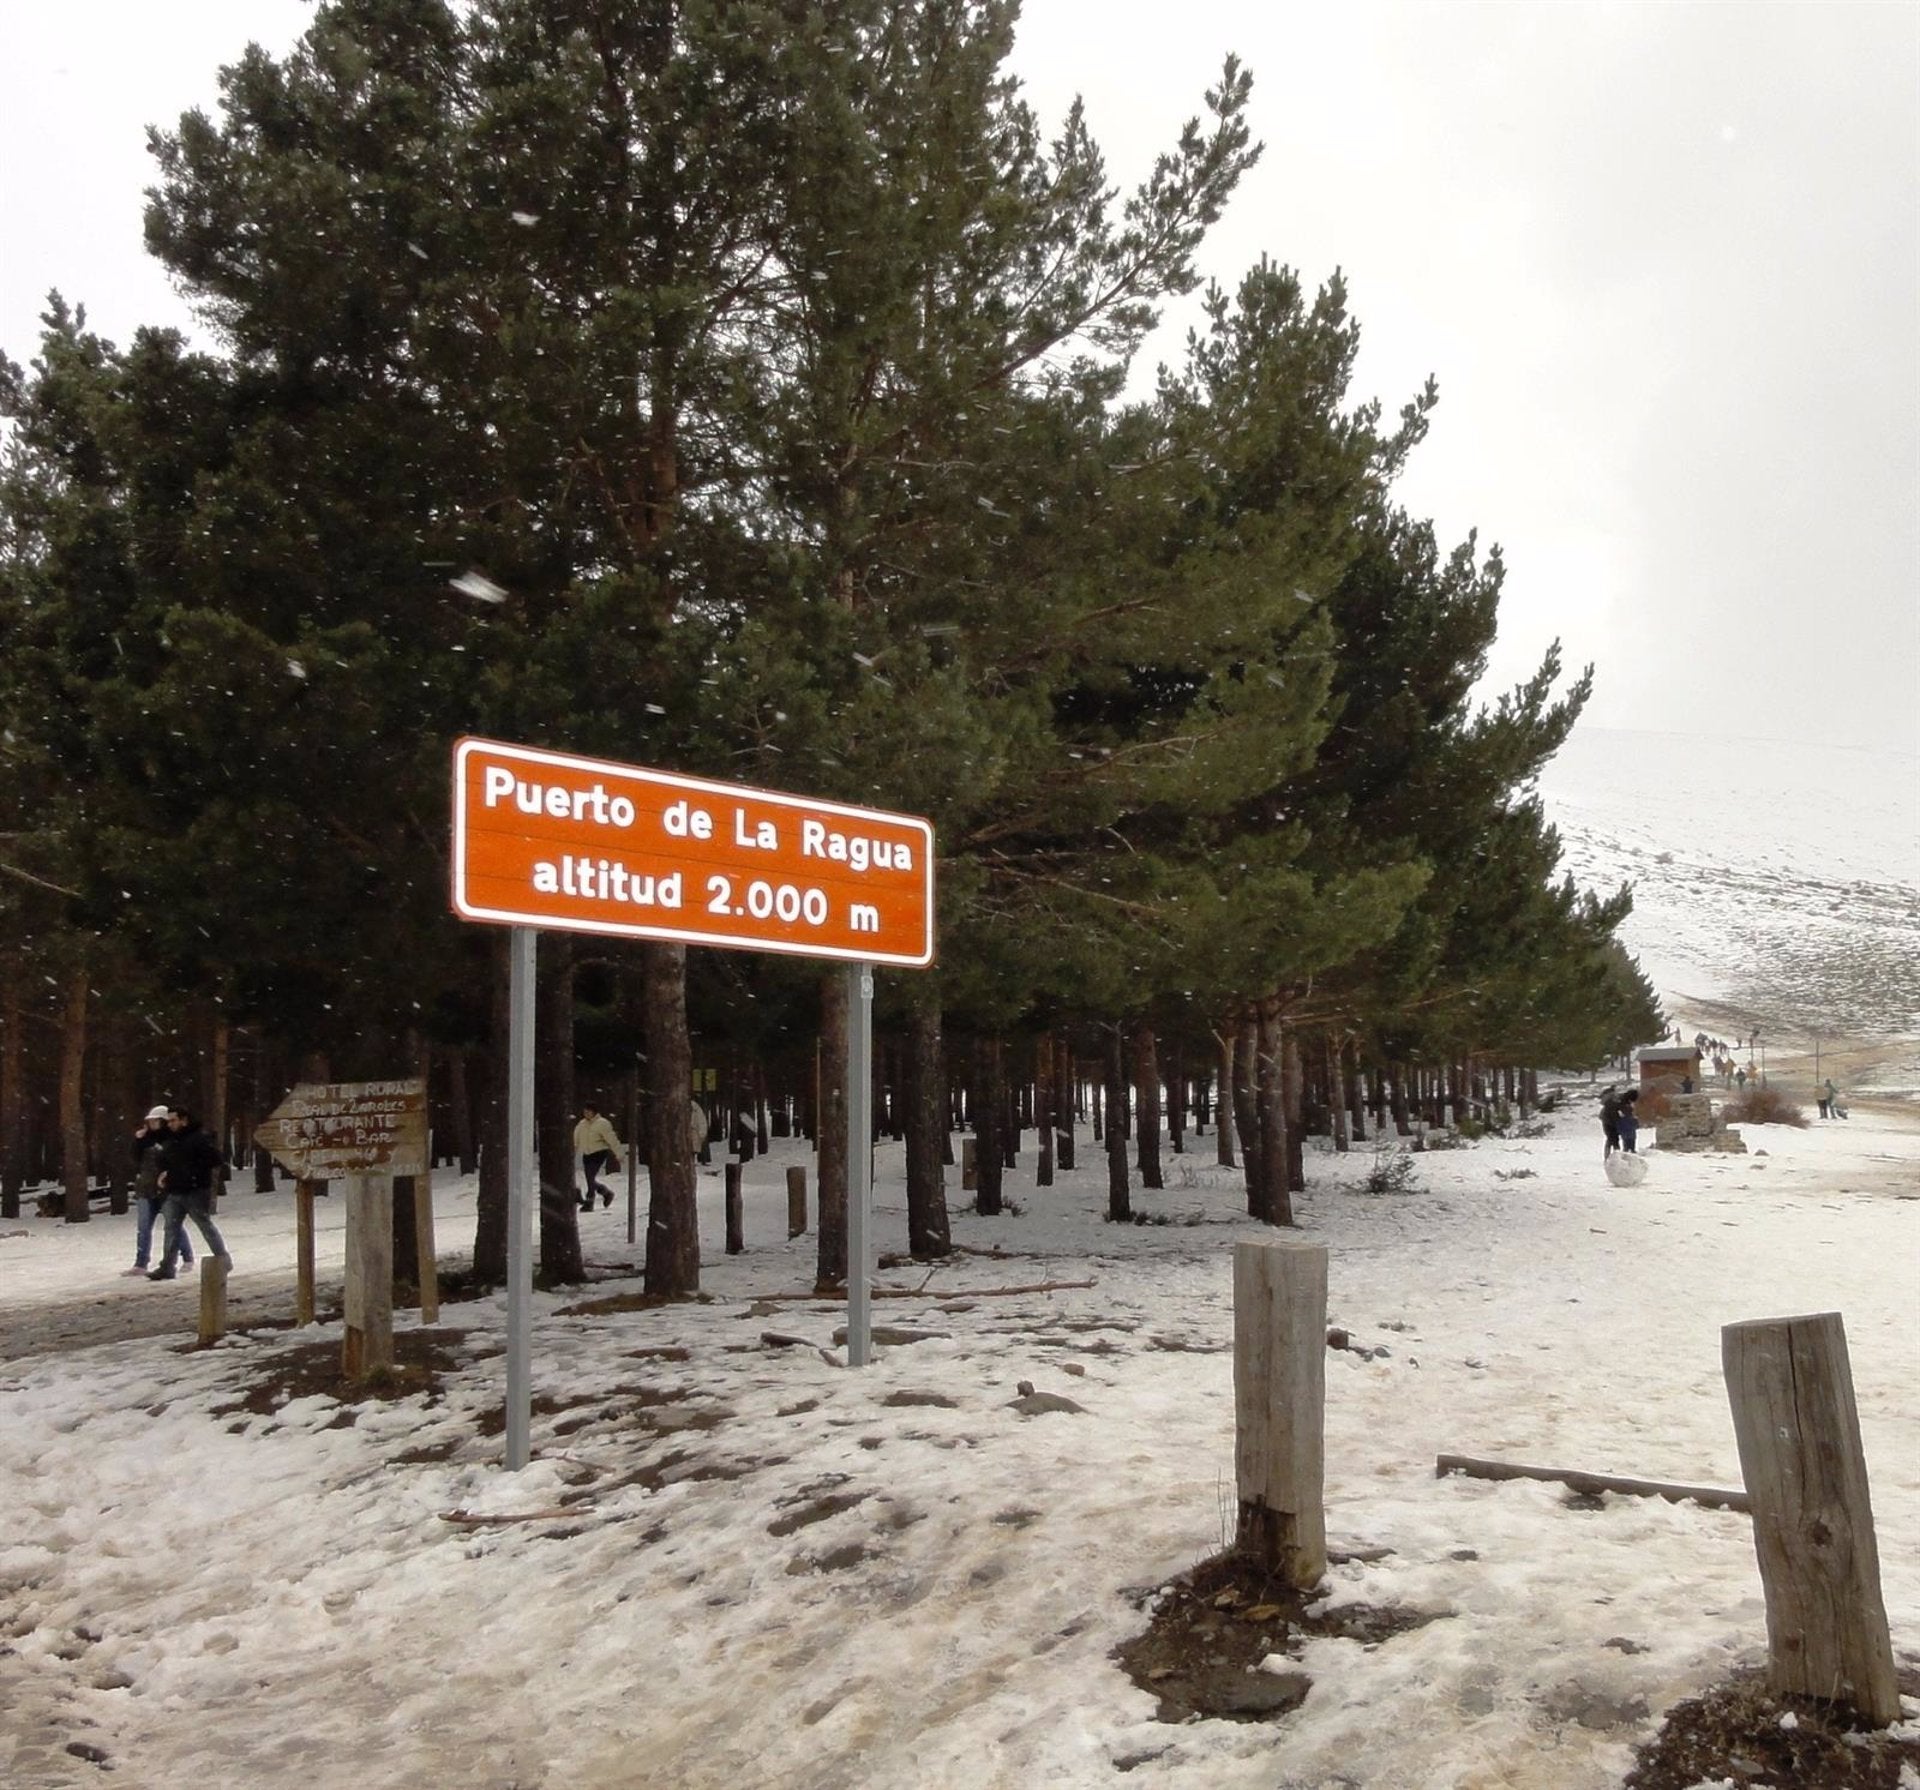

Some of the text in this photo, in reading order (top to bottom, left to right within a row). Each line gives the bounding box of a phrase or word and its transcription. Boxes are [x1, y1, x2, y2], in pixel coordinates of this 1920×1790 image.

[485, 766, 914, 872] Puerto de La Ragua
[532, 855, 879, 932] altitud 2.000 m
[306, 1084, 358, 1099] HOTEL
